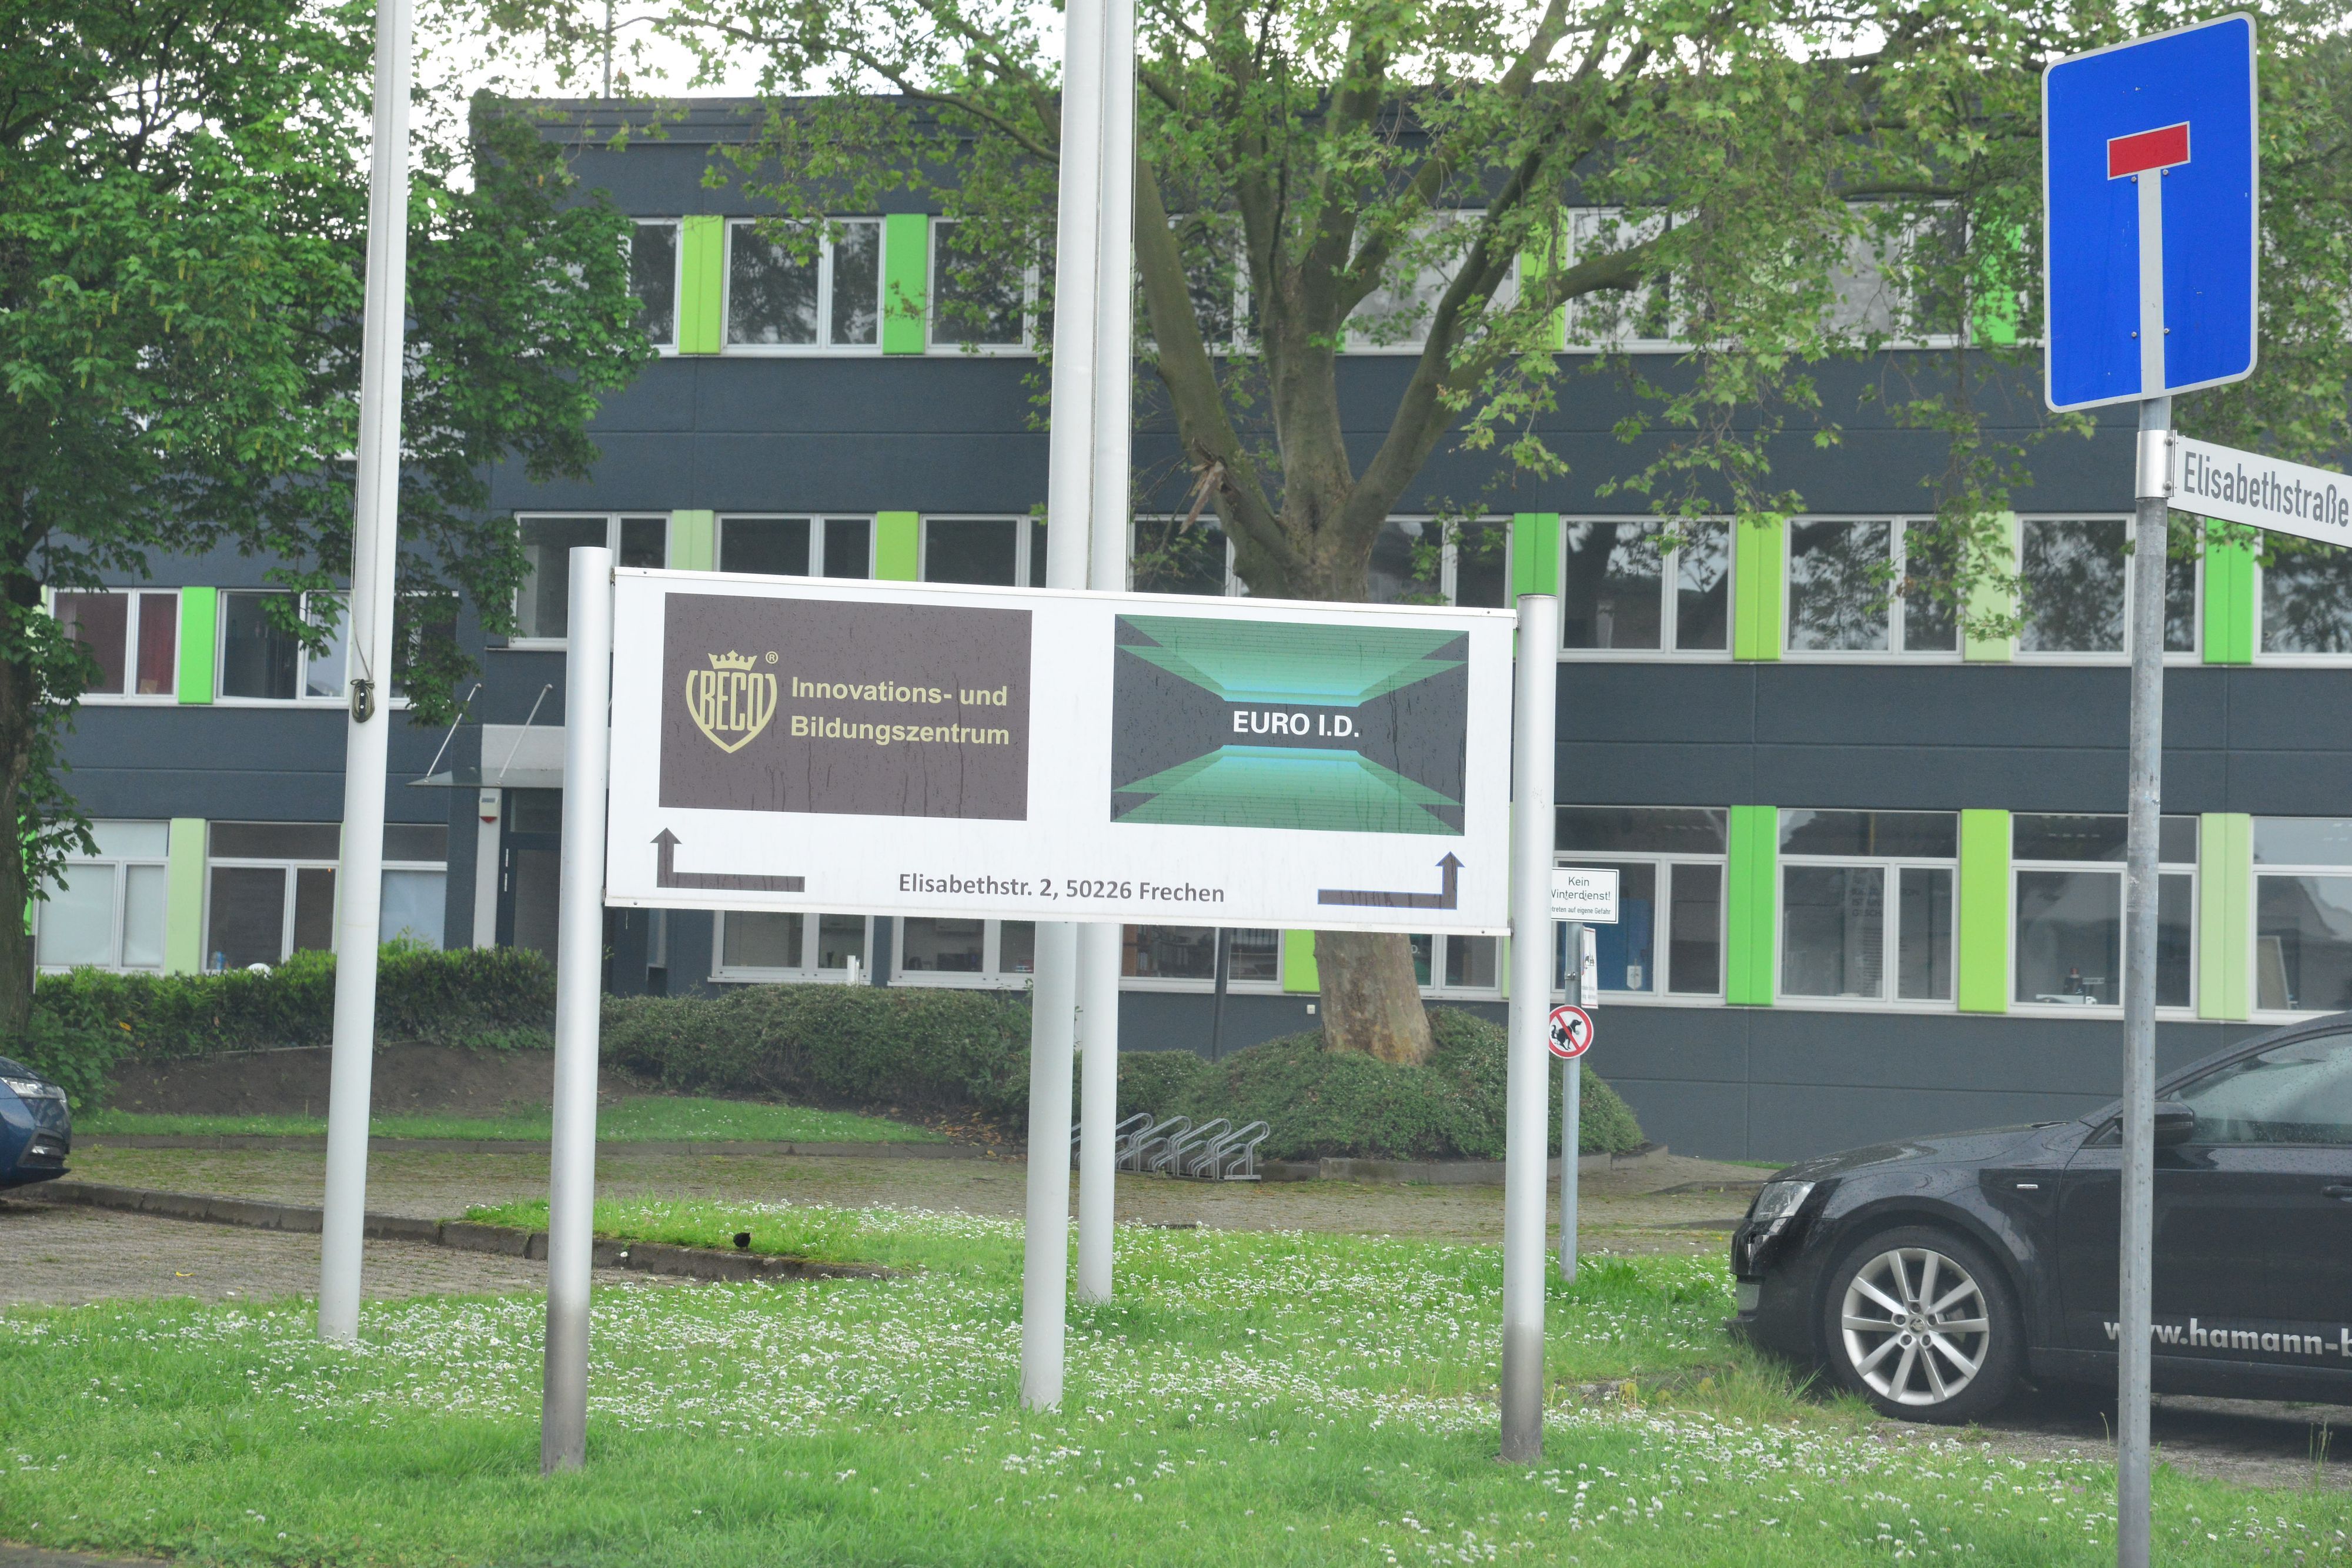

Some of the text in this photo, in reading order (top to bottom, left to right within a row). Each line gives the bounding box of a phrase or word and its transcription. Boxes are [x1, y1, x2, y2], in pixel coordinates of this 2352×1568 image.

[2184, 450, 2349, 527] Elisabethstraße
[699, 670, 764, 731] BECO
[791, 676, 1008, 706] Innovations- und
[791, 715, 1010, 745] Bildungszentrum
[1233, 710, 1359, 738] EURO I.D.
[899, 872, 1225, 902] Elisabethstr. 2, 50226 Frechen
[1568, 876, 1590, 887] Kein
[2103, 1318, 2352, 1358] ww.hamann-b
